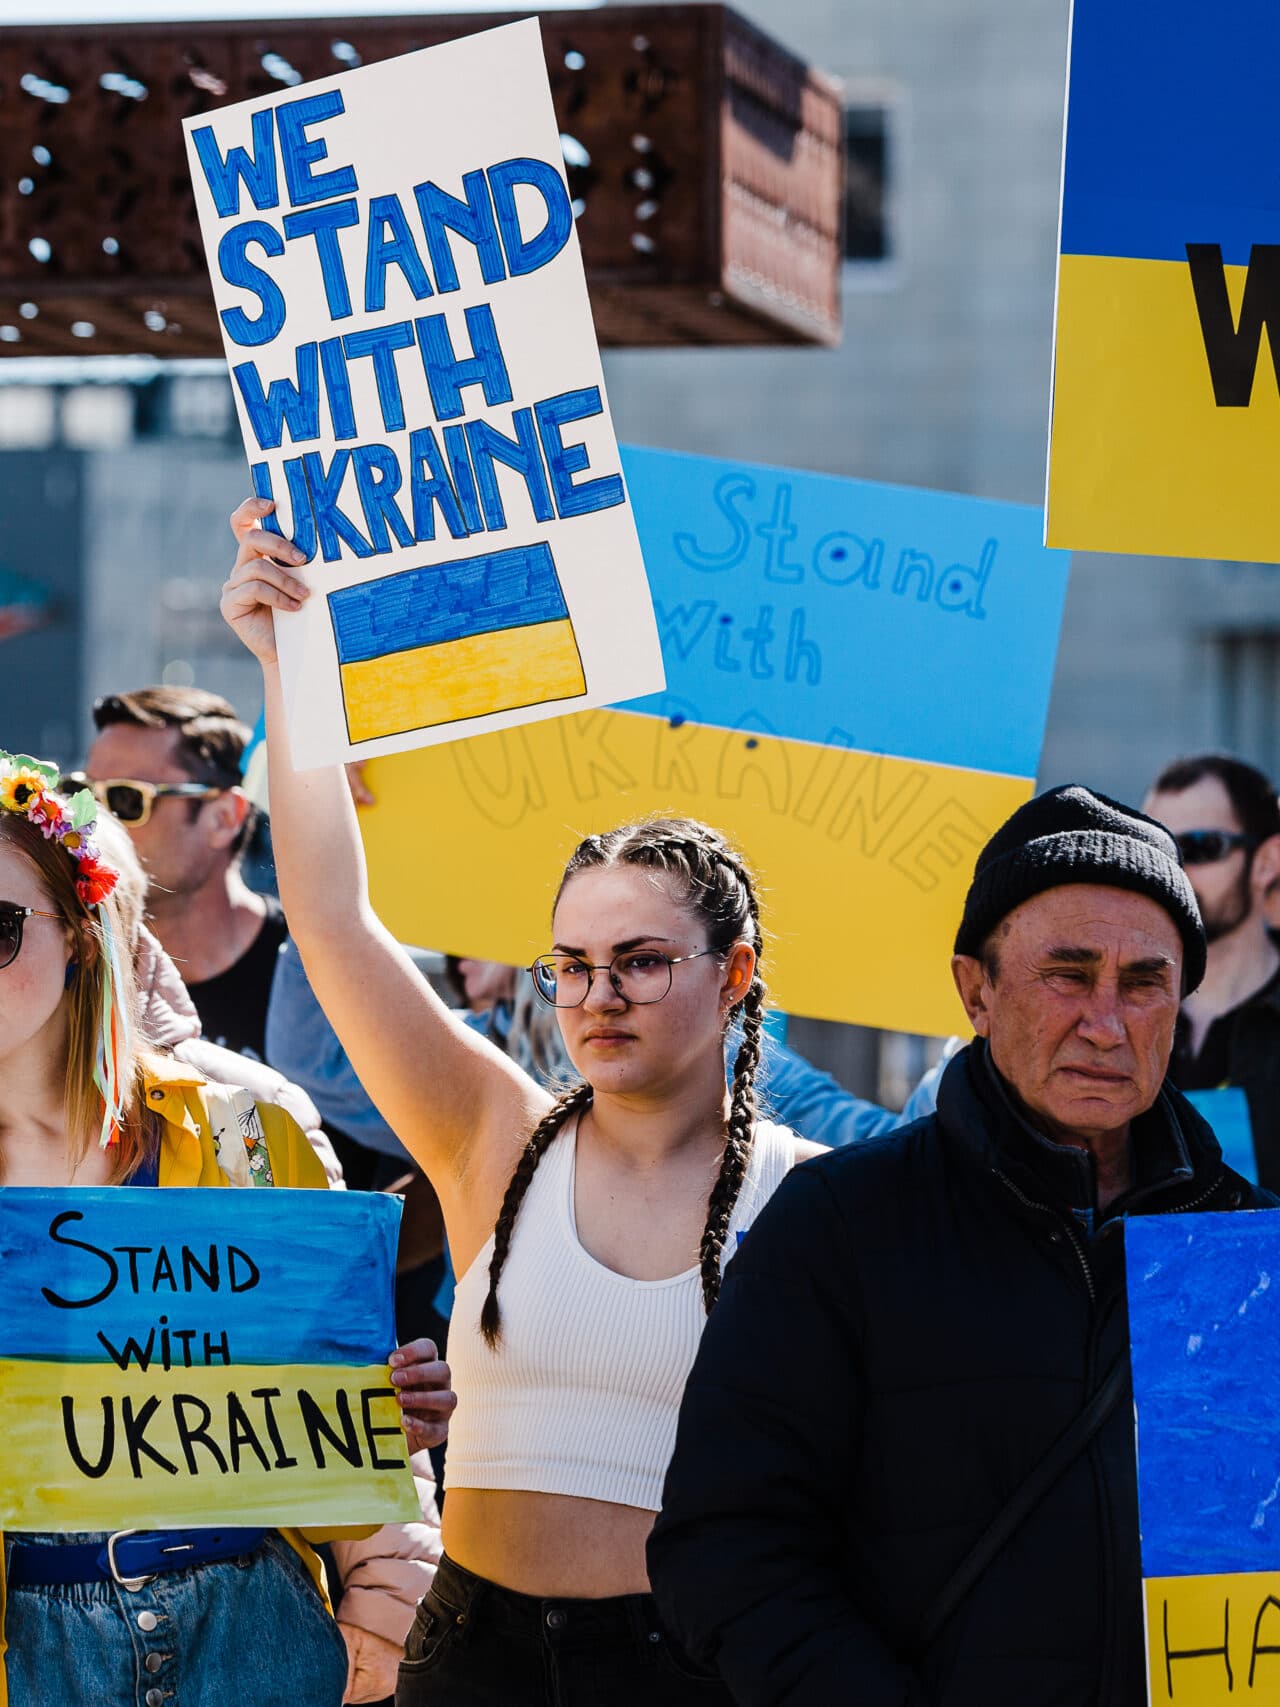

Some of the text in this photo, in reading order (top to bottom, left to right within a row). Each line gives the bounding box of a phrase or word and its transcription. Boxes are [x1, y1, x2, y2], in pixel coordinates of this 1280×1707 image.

[191, 89, 358, 218] WE
[218, 157, 573, 347] STAND
[232, 303, 513, 450] WITH
[250, 386, 625, 567] UKRAINE
[673, 472, 998, 619] Stand
[61, 1387, 407, 1479] UKRAINE
